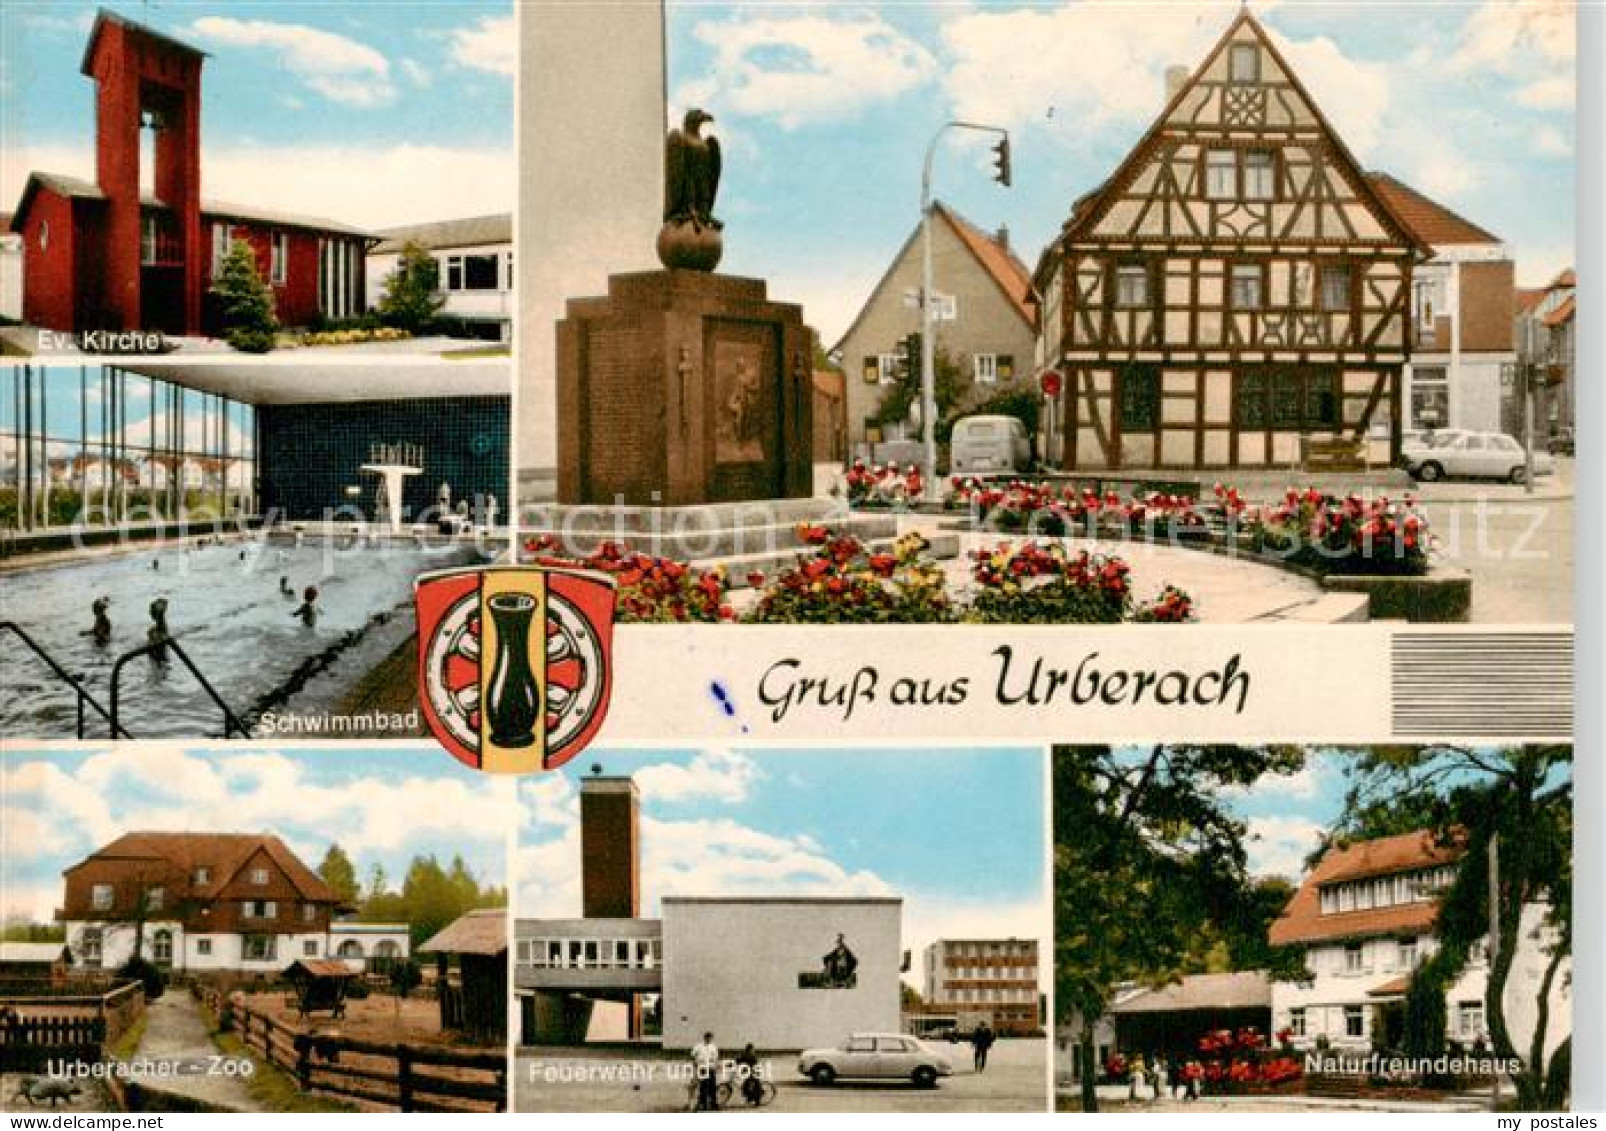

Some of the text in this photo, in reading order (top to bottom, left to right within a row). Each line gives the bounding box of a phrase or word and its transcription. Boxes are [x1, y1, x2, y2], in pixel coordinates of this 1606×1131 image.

[38, 329, 160, 350] Ev. Kirche
[757, 643, 1251, 723] Gruß aus Urberach
[260, 708, 419, 733] Schwimmbad
[47, 1057, 182, 1079] Urberacher
[208, 1055, 254, 1077] Zoo
[529, 1058, 773, 1083] Feuerwehr und Post
[1304, 1052, 1522, 1075] Naturfreundehaus
